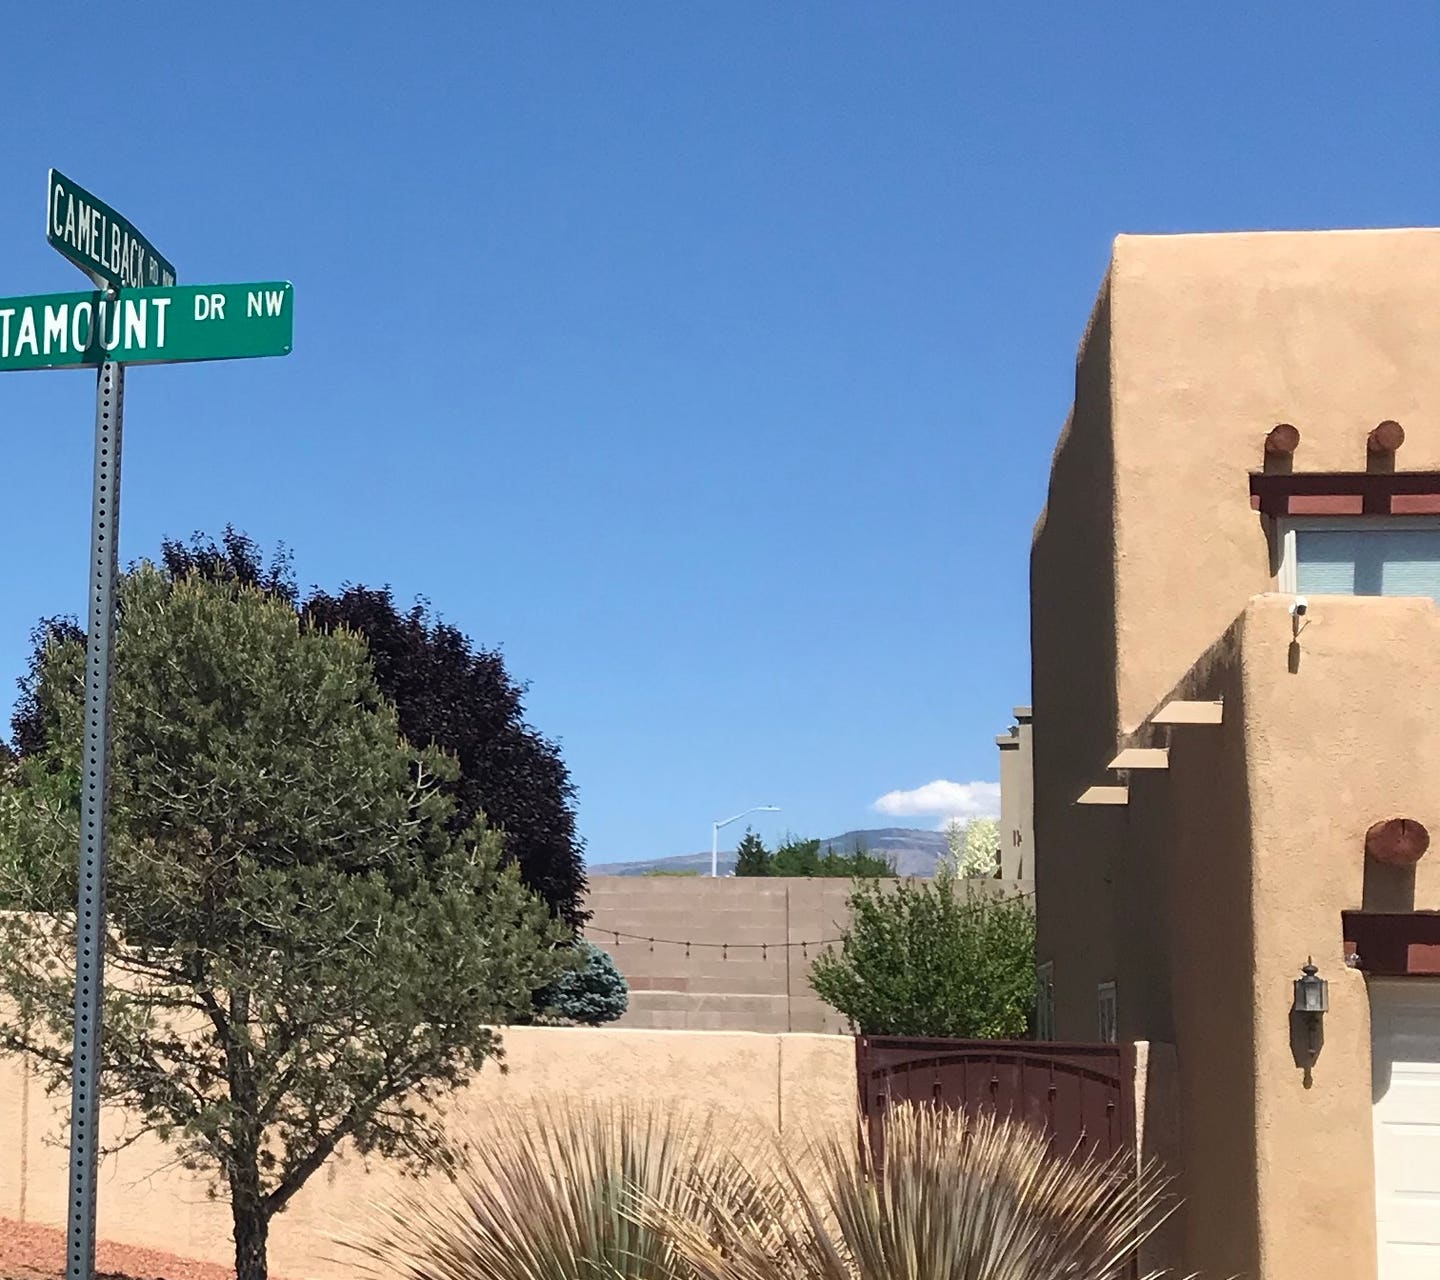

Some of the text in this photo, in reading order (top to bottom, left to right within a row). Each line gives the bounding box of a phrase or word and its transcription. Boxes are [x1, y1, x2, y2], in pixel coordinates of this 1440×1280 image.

[52, 183, 145, 289] CAMELBACK
[193, 293, 226, 321] DR
[246, 290, 285, 318] NW
